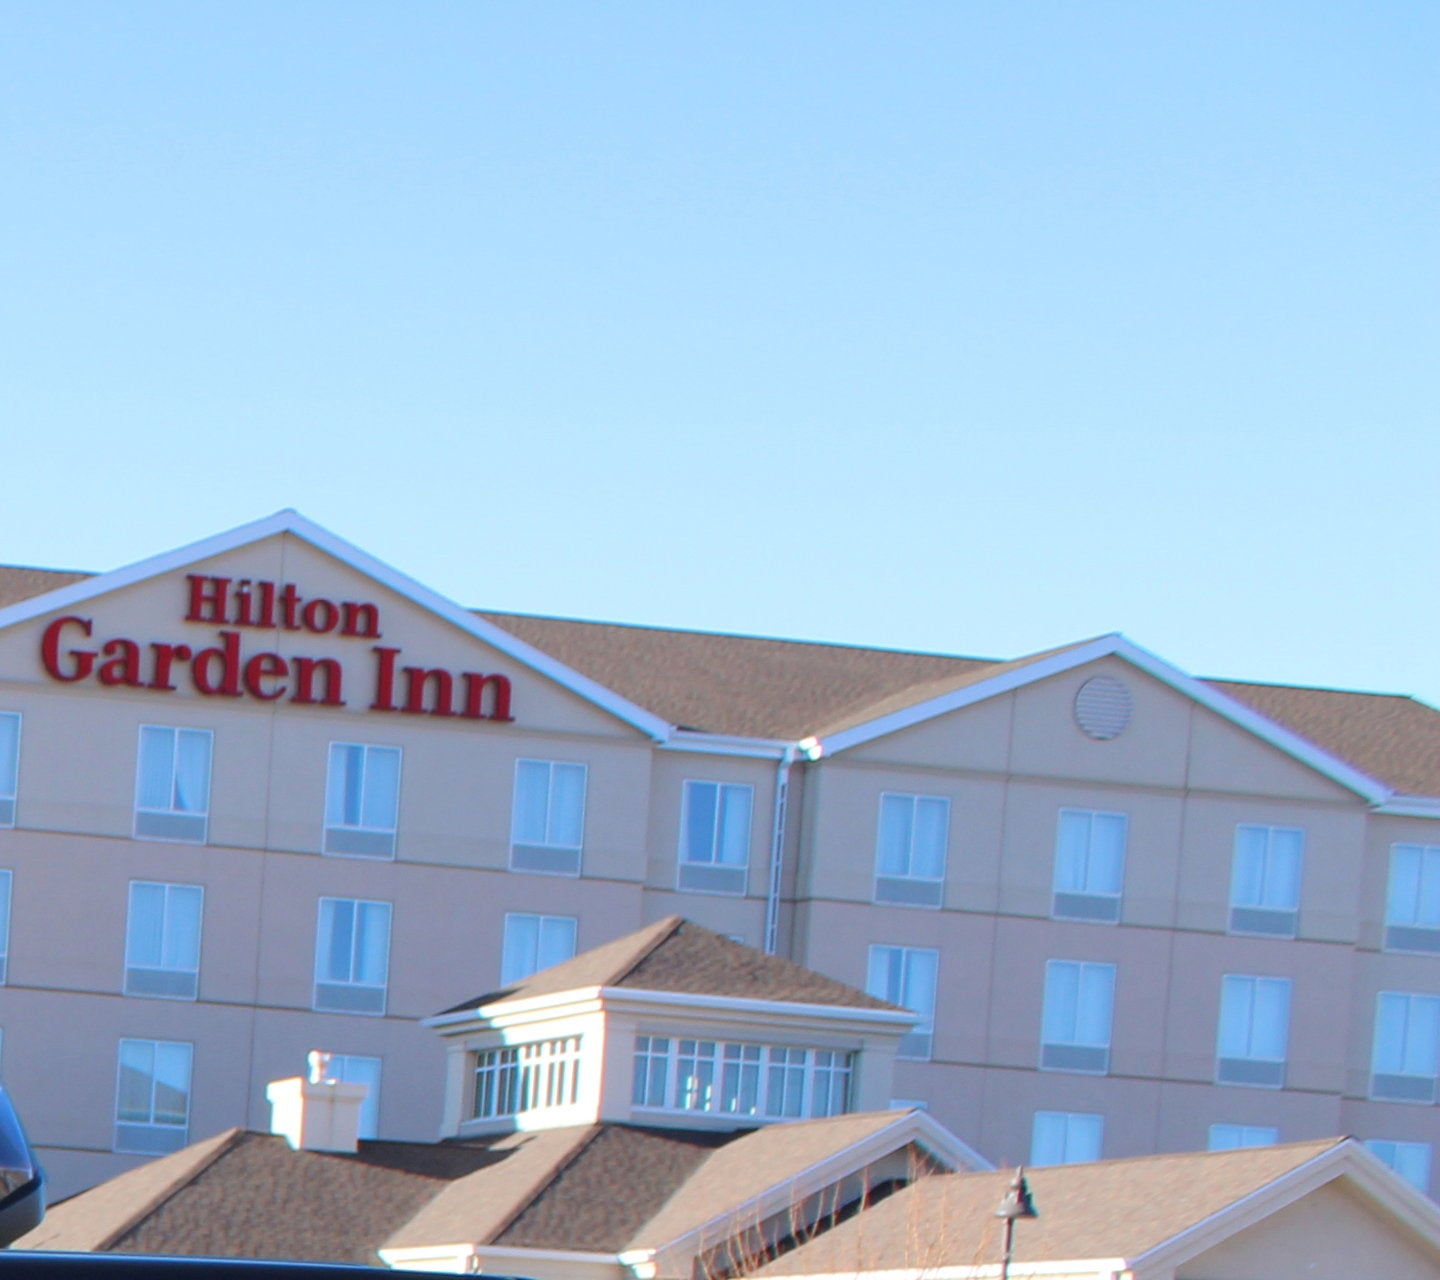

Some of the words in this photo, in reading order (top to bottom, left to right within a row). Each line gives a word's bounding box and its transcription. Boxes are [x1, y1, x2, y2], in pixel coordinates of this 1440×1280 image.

[185, 574, 382, 638] Hilton
[41, 615, 345, 706] Garden
[370, 646, 514, 722] Inn
